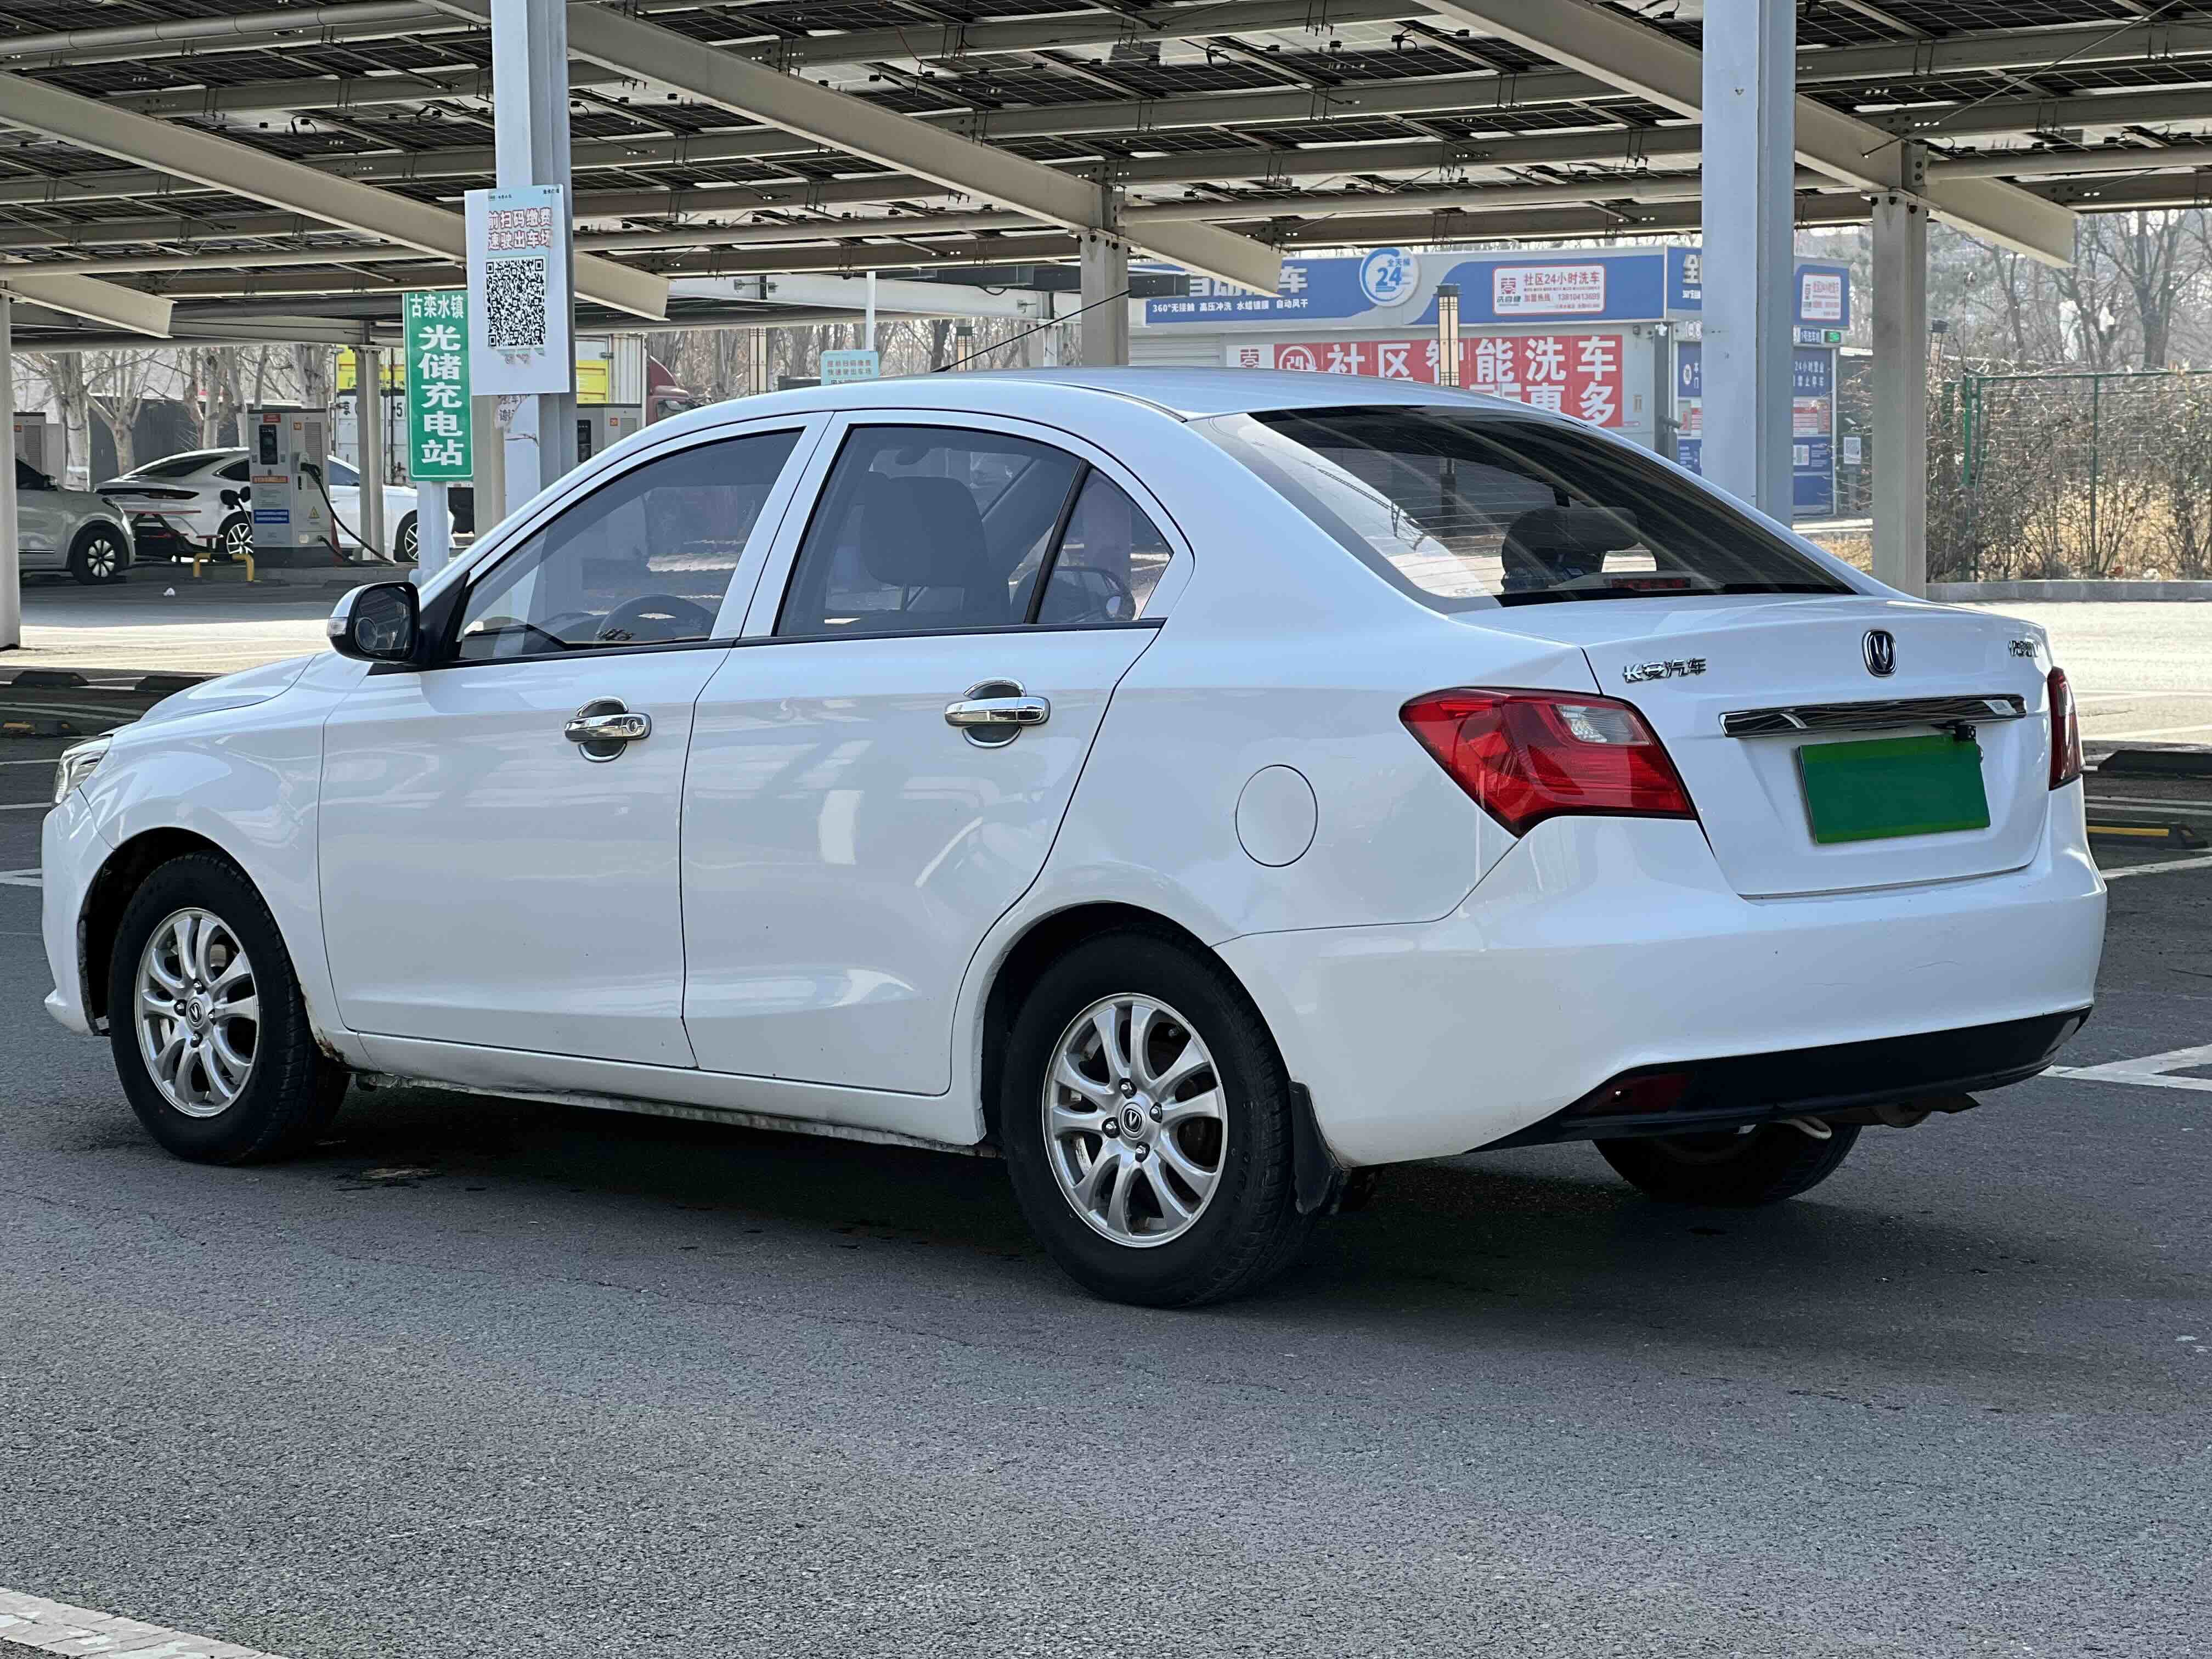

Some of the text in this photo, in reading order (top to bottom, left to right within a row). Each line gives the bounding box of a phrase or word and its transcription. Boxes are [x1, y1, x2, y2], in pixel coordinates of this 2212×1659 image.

[1376, 267, 1402, 286] 24
[1523, 271, 1600, 286] 社区24小时洗车
[1277, 299, 1308, 309] 自动风干
[417, 324, 465, 466] 光储充电站
[1622, 658, 1707, 683] 长安汽车
